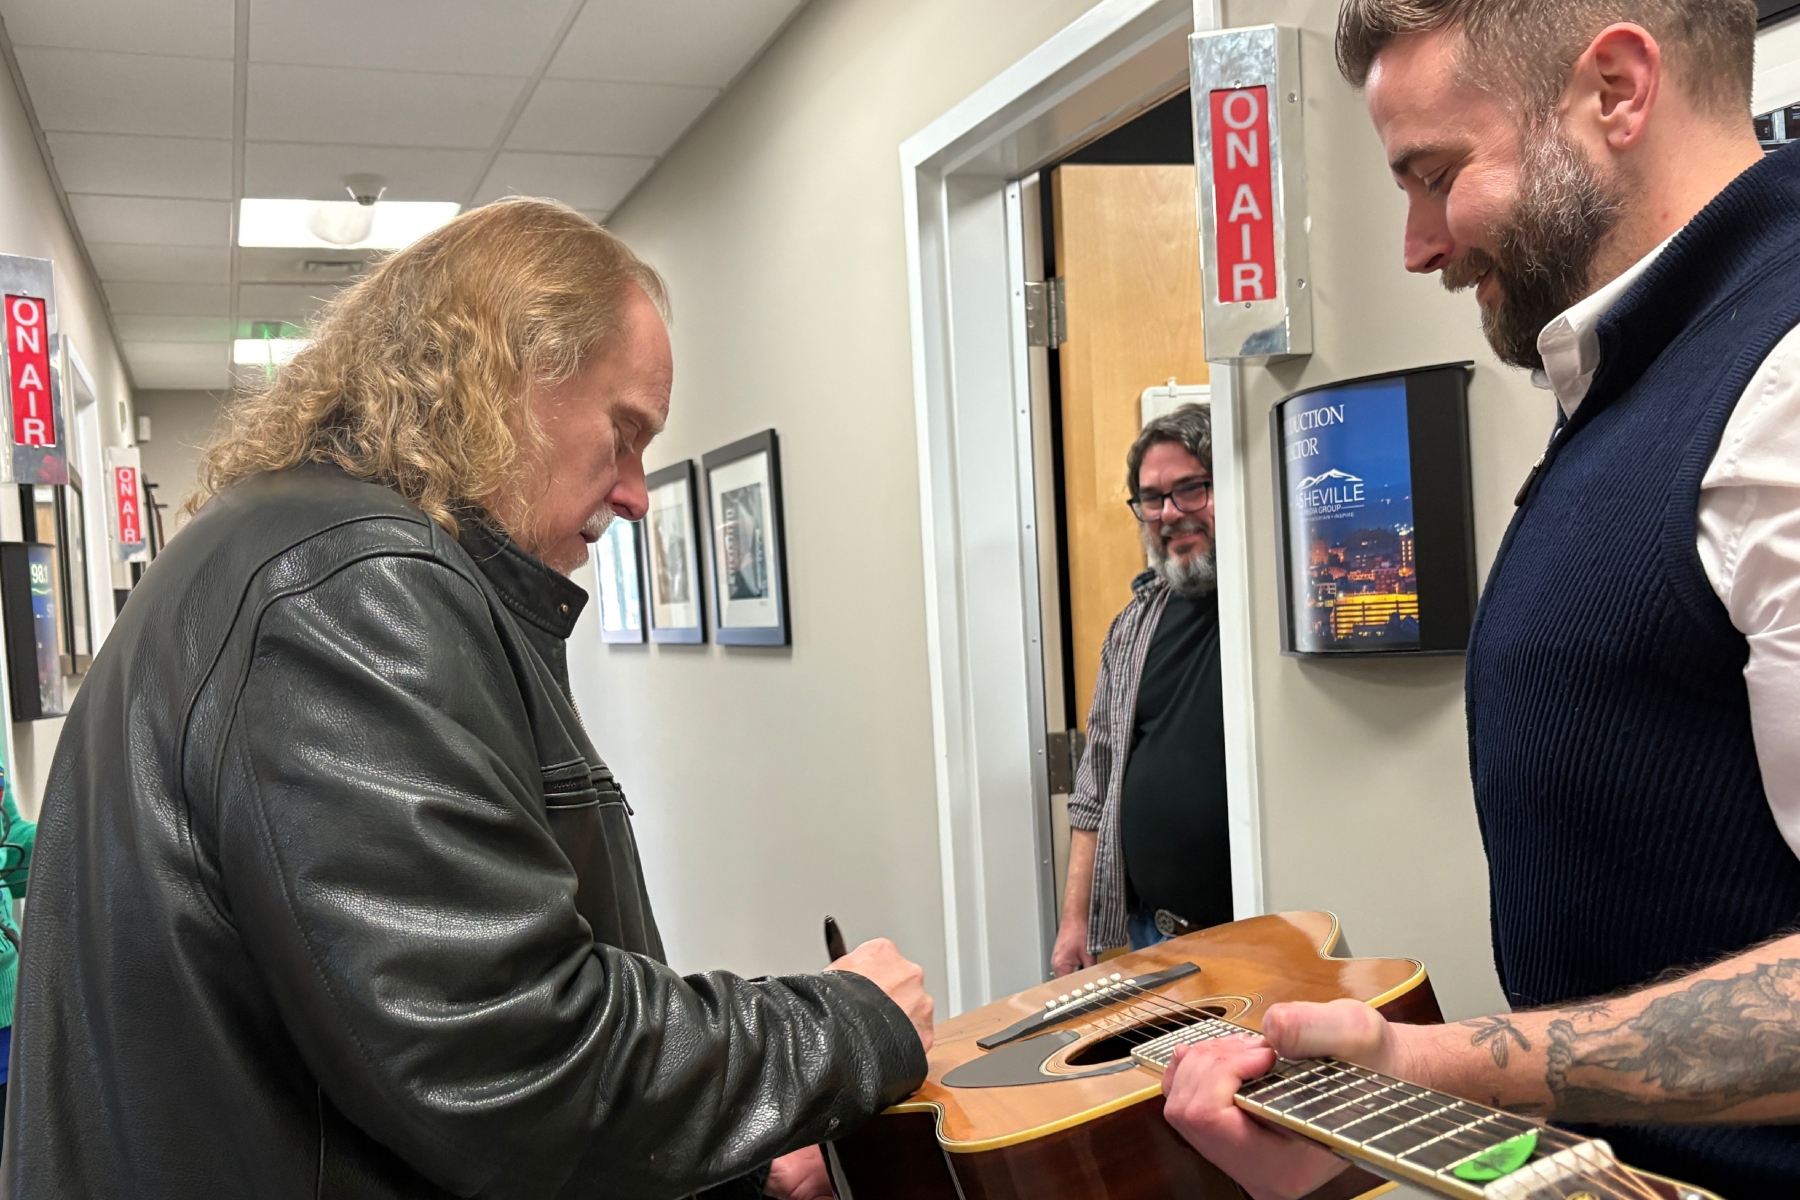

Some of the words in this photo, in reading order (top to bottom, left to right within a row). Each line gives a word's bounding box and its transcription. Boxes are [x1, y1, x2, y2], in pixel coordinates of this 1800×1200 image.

[1222, 90, 1259, 170] ON
[1227, 183, 1264, 301] AIR
[12, 298, 41, 354] ON
[19, 363, 46, 445] AIR
[118, 468, 133, 497] ON
[121, 500, 136, 542] AIR
[1318, 504, 1342, 514] GROUP
[31, 563, 48, 584] 98.1
